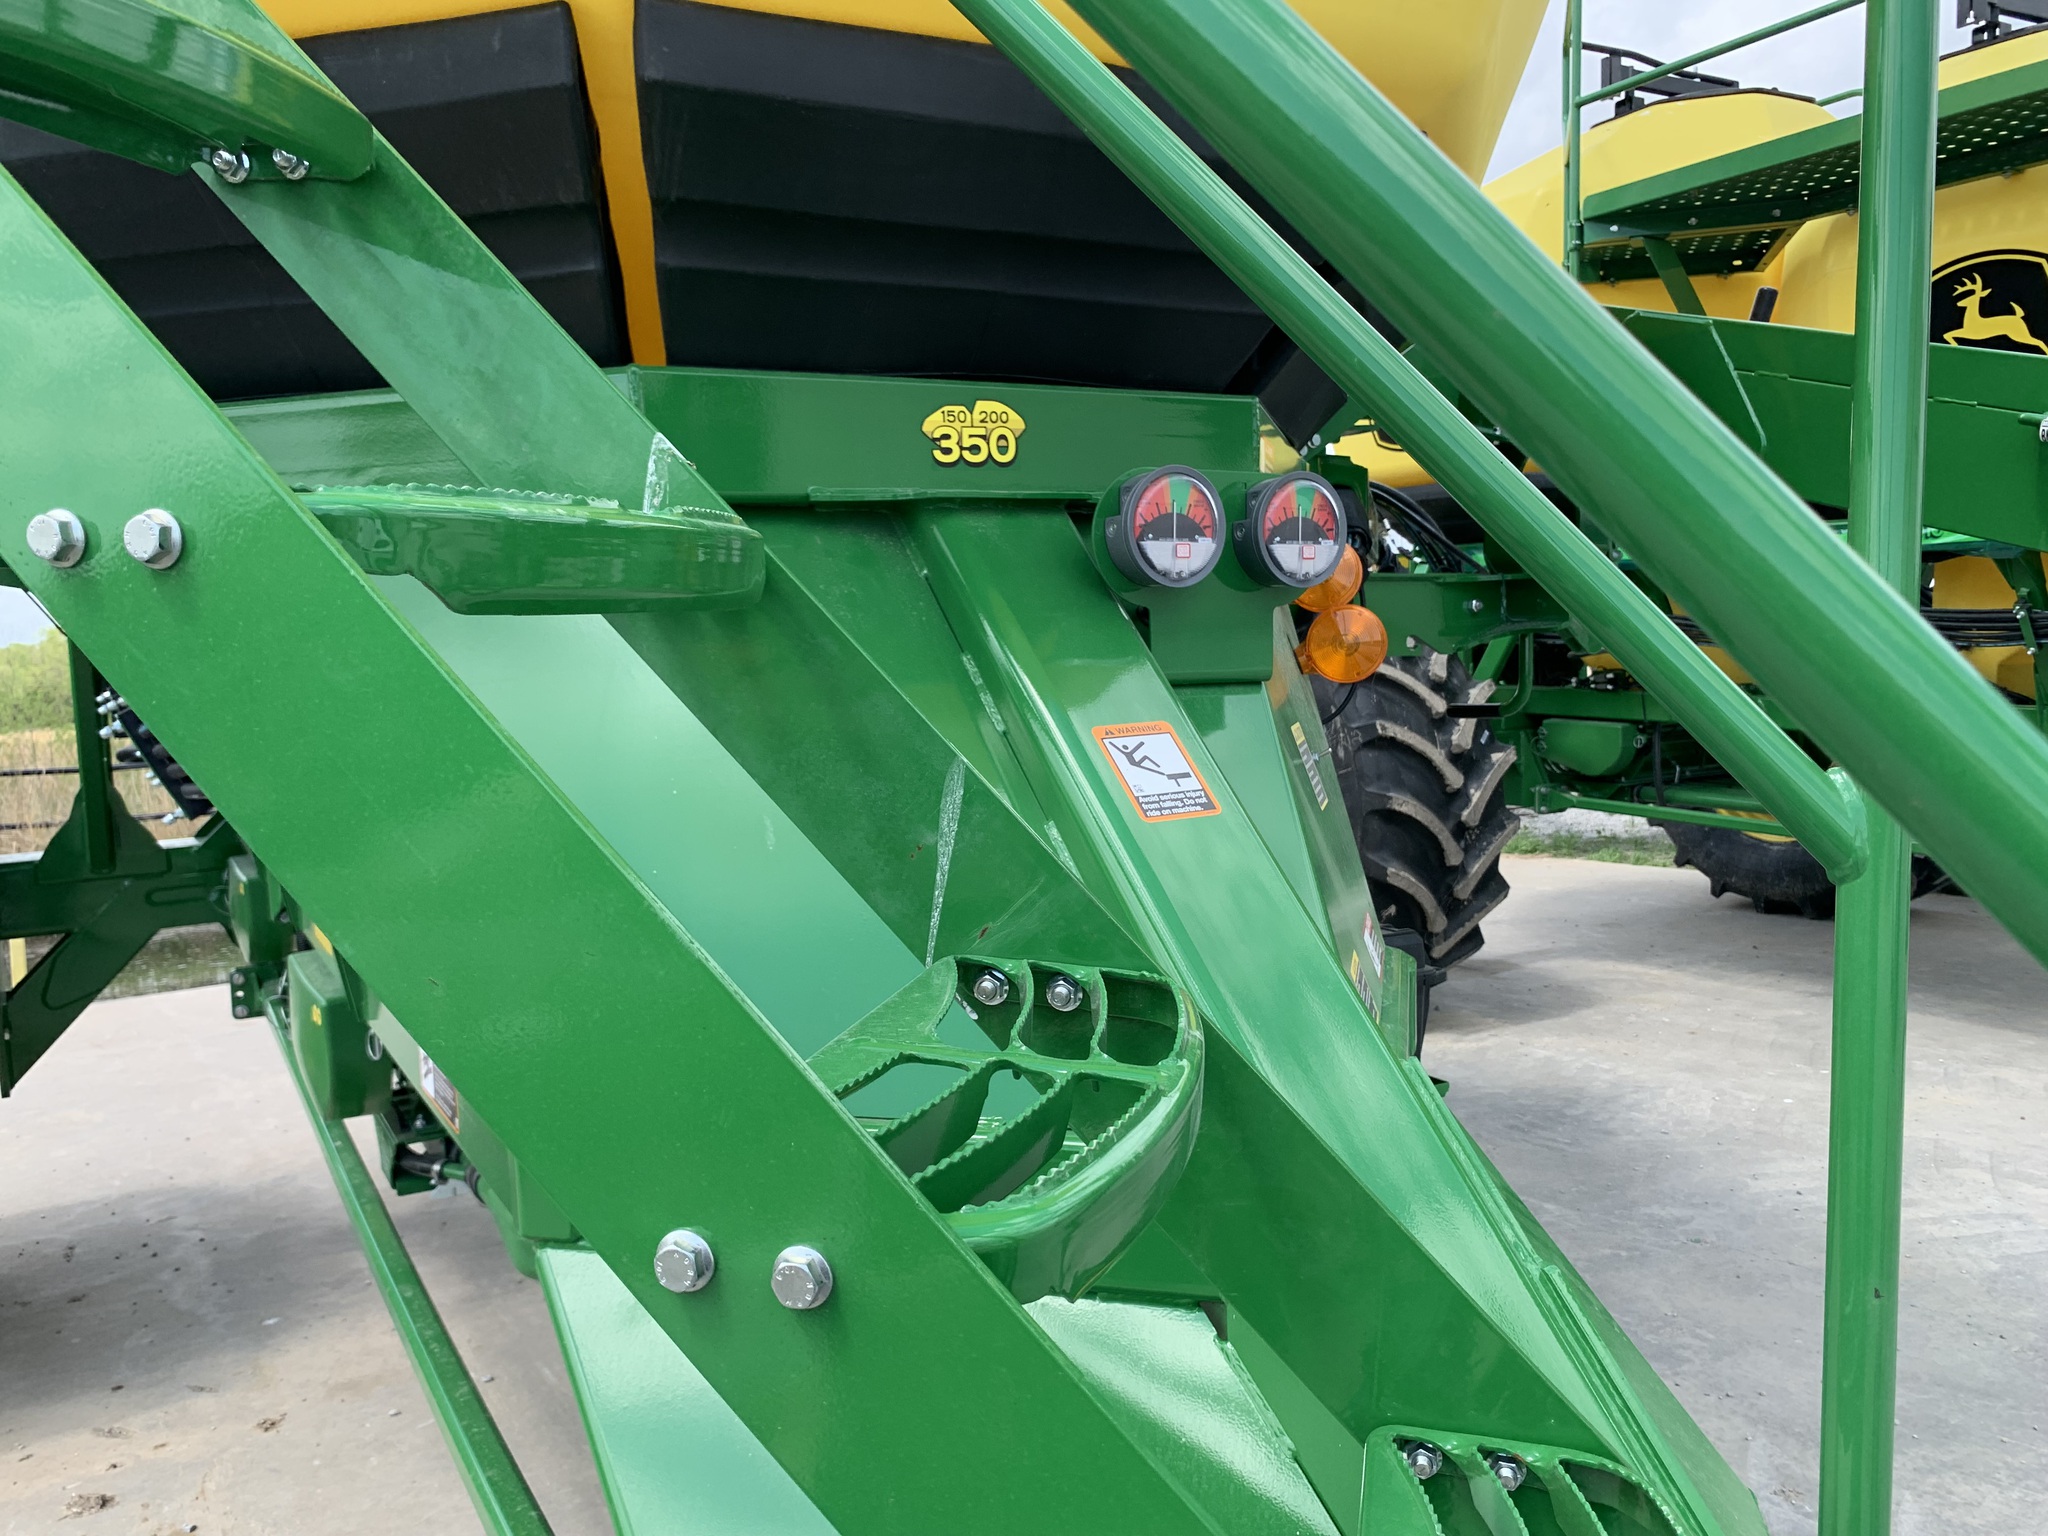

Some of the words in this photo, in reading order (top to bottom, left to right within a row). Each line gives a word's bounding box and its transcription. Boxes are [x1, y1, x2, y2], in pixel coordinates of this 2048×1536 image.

[940, 410, 967, 423] 150
[979, 411, 1009, 424] 200
[931, 425, 1018, 466] 350
[1115, 724, 1162, 735] WARNING
[1185, 790, 1204, 798] injury
[1142, 801, 1160, 810] from
[1160, 799, 1184, 808] falling.
[1184, 797, 1195, 805] Do
[1195, 796, 1208, 804] not
[1146, 808, 1161, 817] ride
[1161, 808, 1172, 816] on
[1172, 805, 1204, 813] machine.
